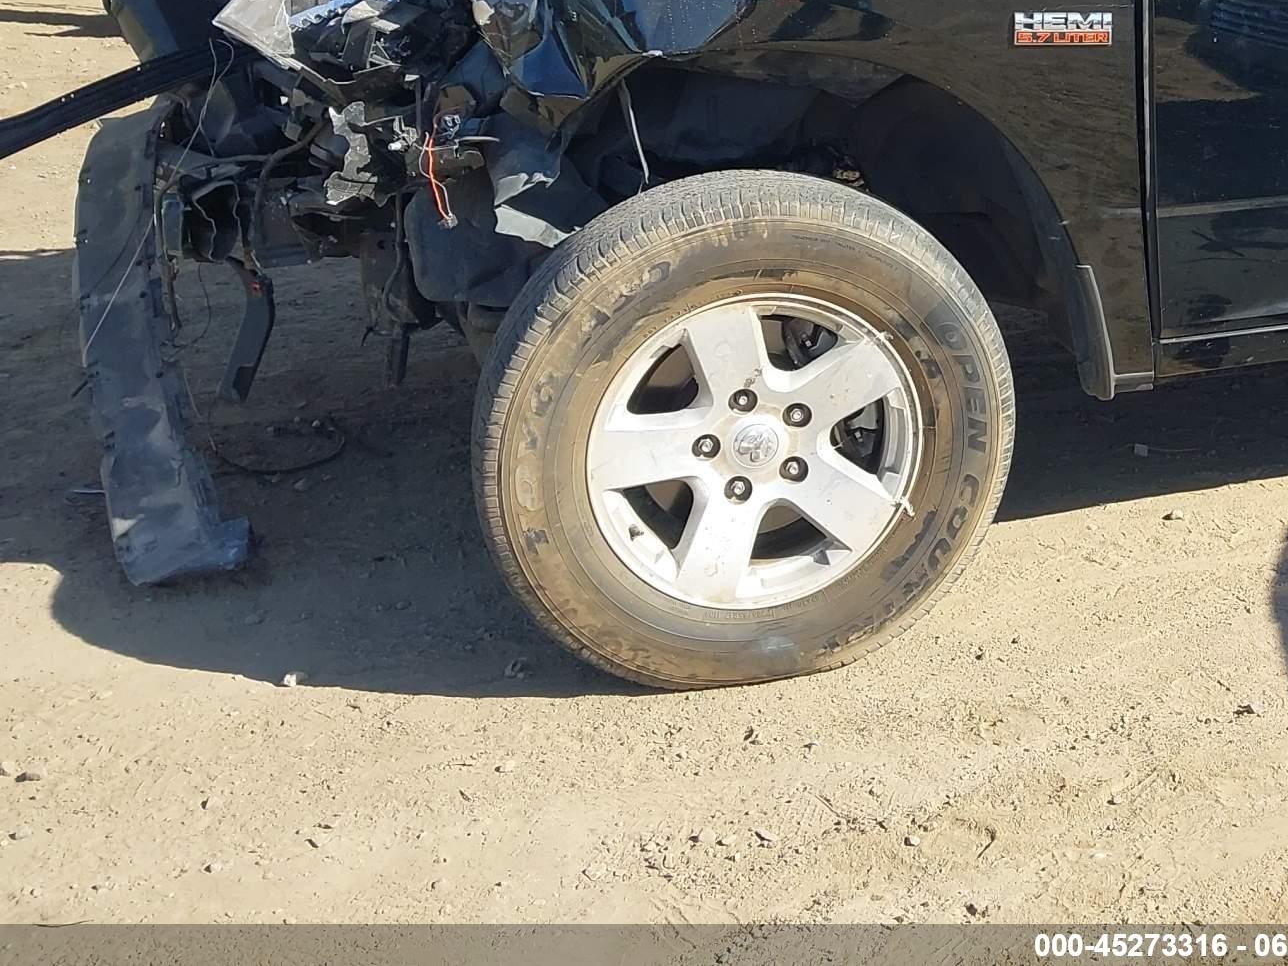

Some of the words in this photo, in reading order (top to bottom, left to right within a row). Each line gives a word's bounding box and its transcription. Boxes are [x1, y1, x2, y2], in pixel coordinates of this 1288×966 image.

[1014, 12, 1112, 31] HEMI
[1017, 32, 1051, 43] 5.7
[1053, 32, 1108, 43] LITER
[935, 320, 988, 454] OPEN
